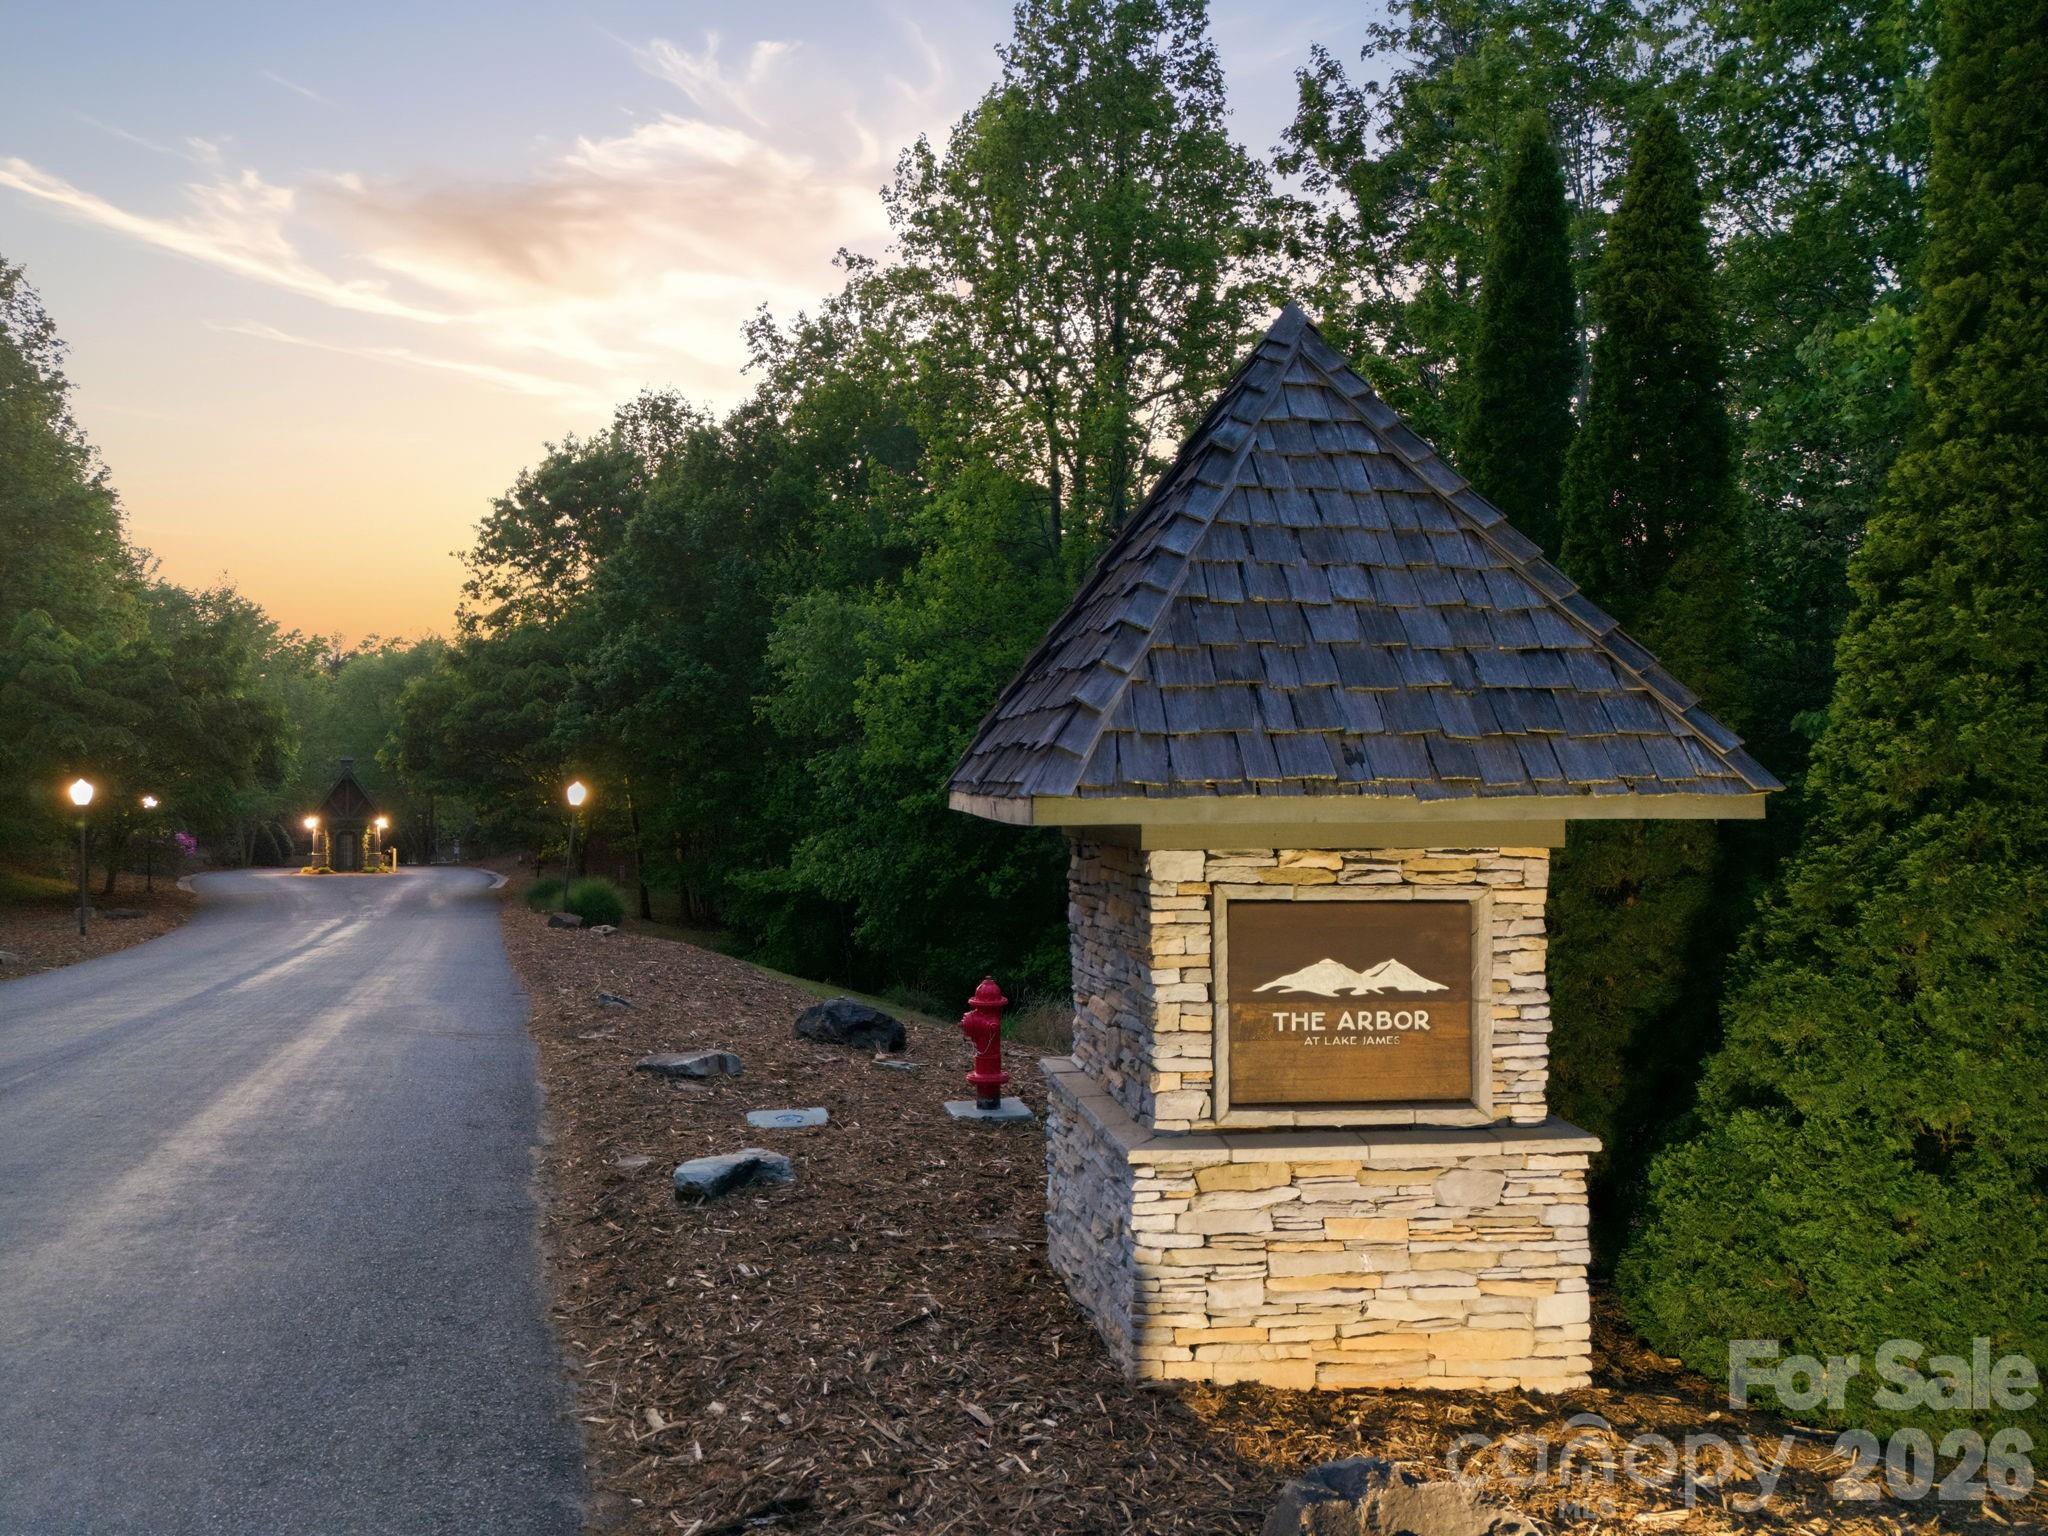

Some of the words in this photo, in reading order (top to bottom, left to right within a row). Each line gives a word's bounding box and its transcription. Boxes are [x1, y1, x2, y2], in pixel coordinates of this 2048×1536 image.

[1272, 1011, 1327, 1032] THE
[1336, 1009, 1431, 1032] ARBOR
[1304, 1036, 1319, 1046] AT
[1324, 1036, 1358, 1046] LAKE
[1362, 1035, 1400, 1046] JAMES
